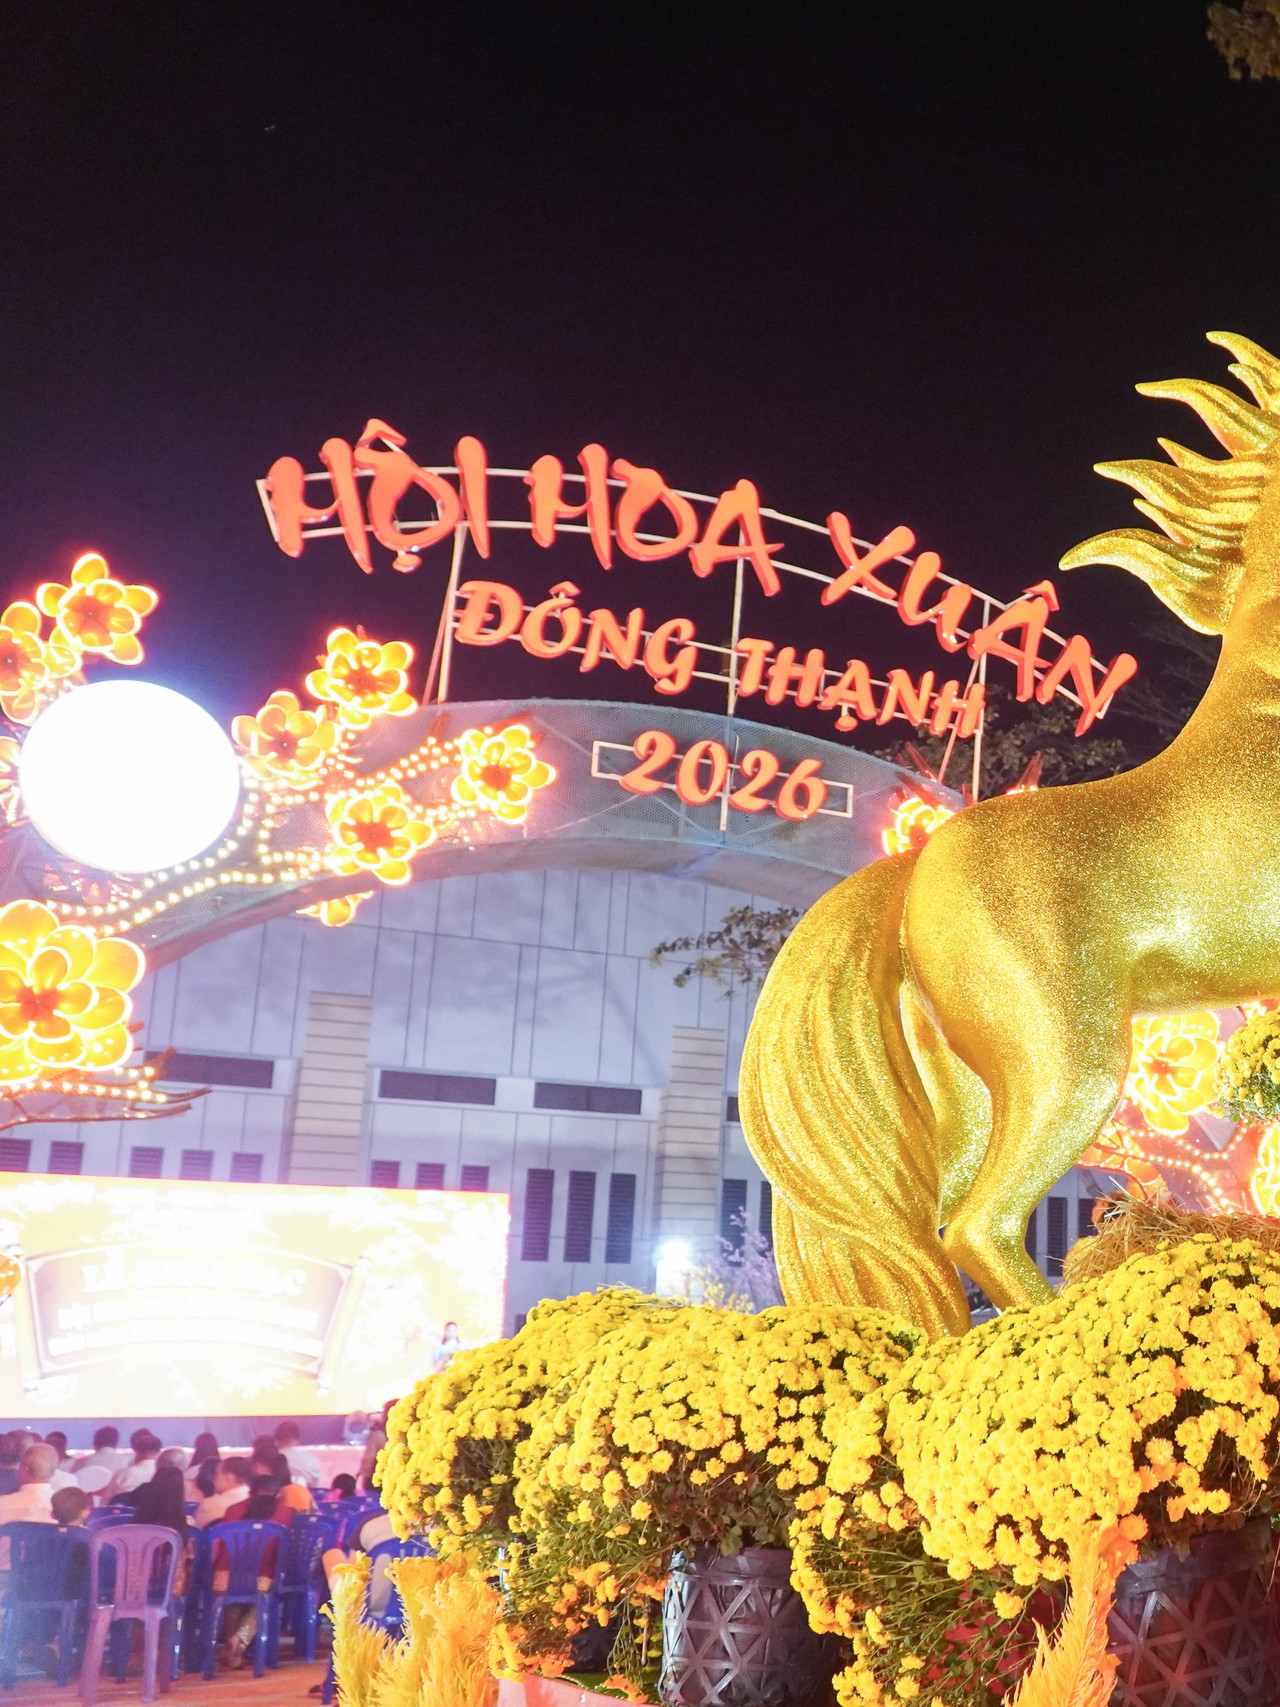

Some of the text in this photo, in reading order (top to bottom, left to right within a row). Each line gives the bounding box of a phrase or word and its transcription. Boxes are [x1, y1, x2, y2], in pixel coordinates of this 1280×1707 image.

[266, 418, 1138, 738] HỘI HOA XUÂN
[455, 580, 986, 739] ĐÔNG THẠNH
[618, 730, 827, 821] 2026
